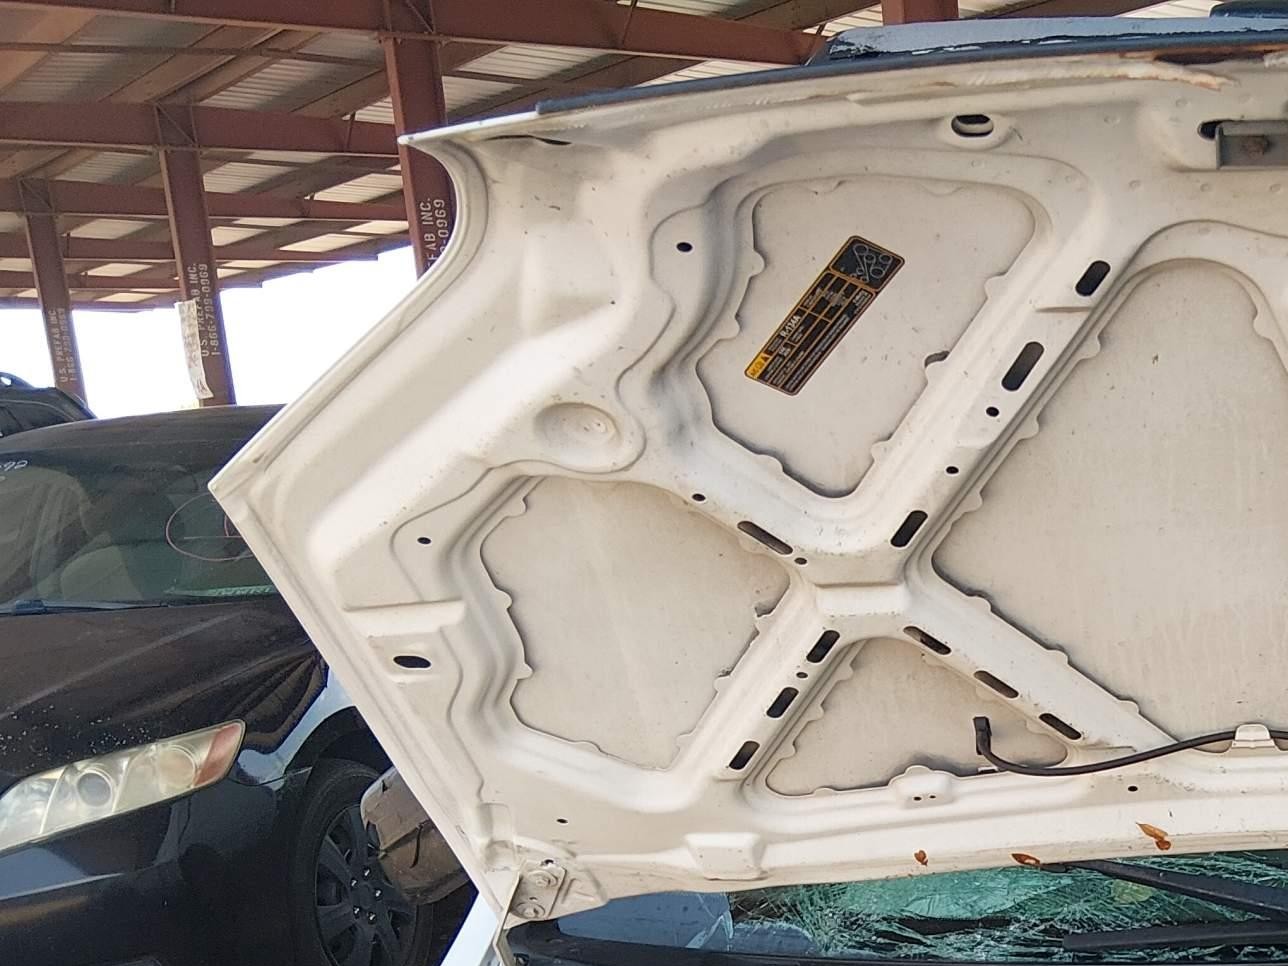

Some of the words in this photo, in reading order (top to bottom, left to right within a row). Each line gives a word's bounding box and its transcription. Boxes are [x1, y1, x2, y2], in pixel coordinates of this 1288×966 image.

[419, 197, 434, 225] INC.
[187, 262, 198, 284] INC.
[51, 327, 66, 362] PREFAB
